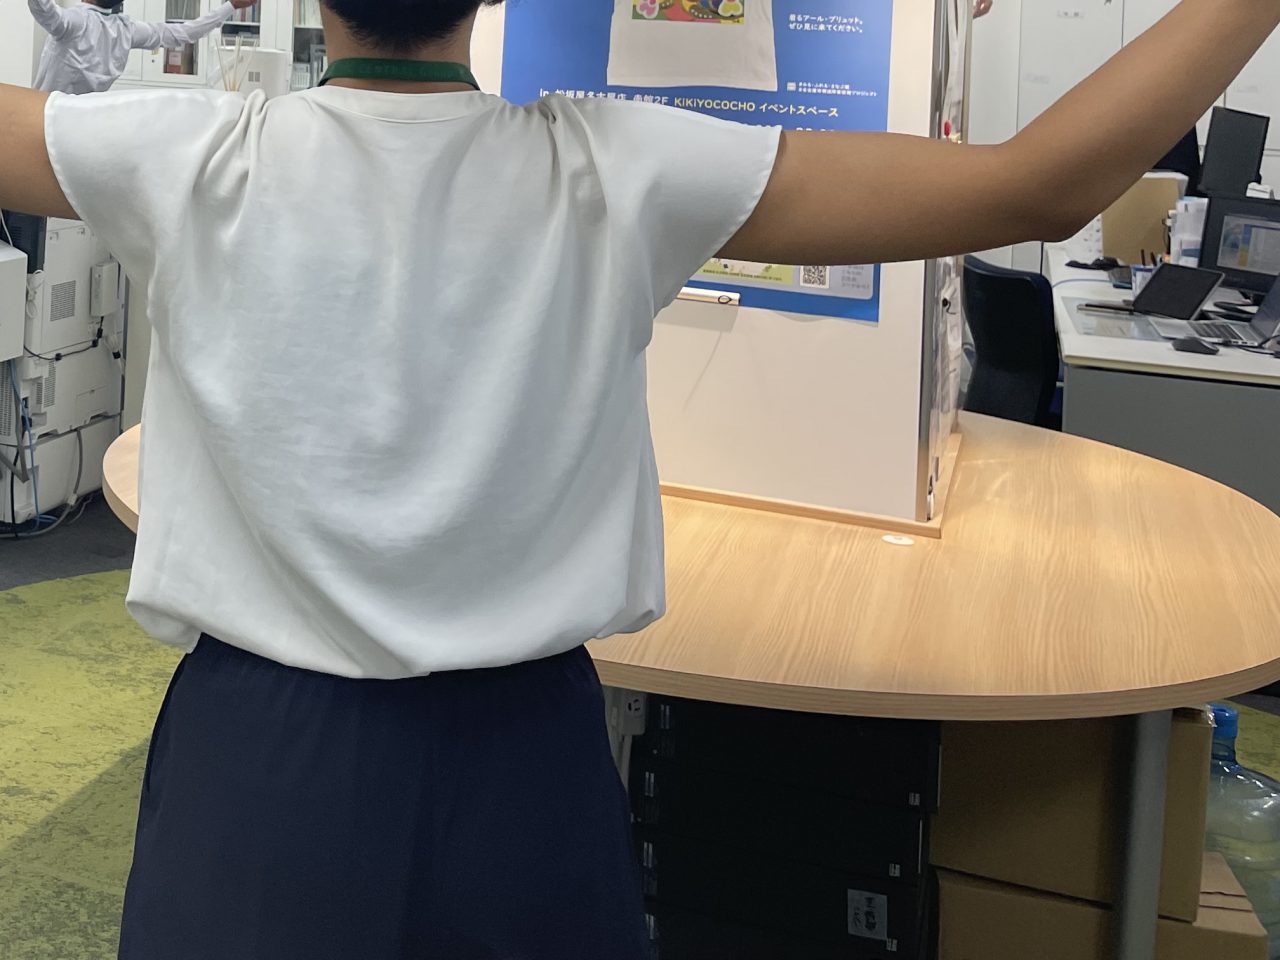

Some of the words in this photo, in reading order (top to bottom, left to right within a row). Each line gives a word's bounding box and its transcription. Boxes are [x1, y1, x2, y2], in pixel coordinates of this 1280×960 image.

[674, 97, 756, 111] KIKIYOCOCHO
[759, 102, 839, 117] イベントスペース
